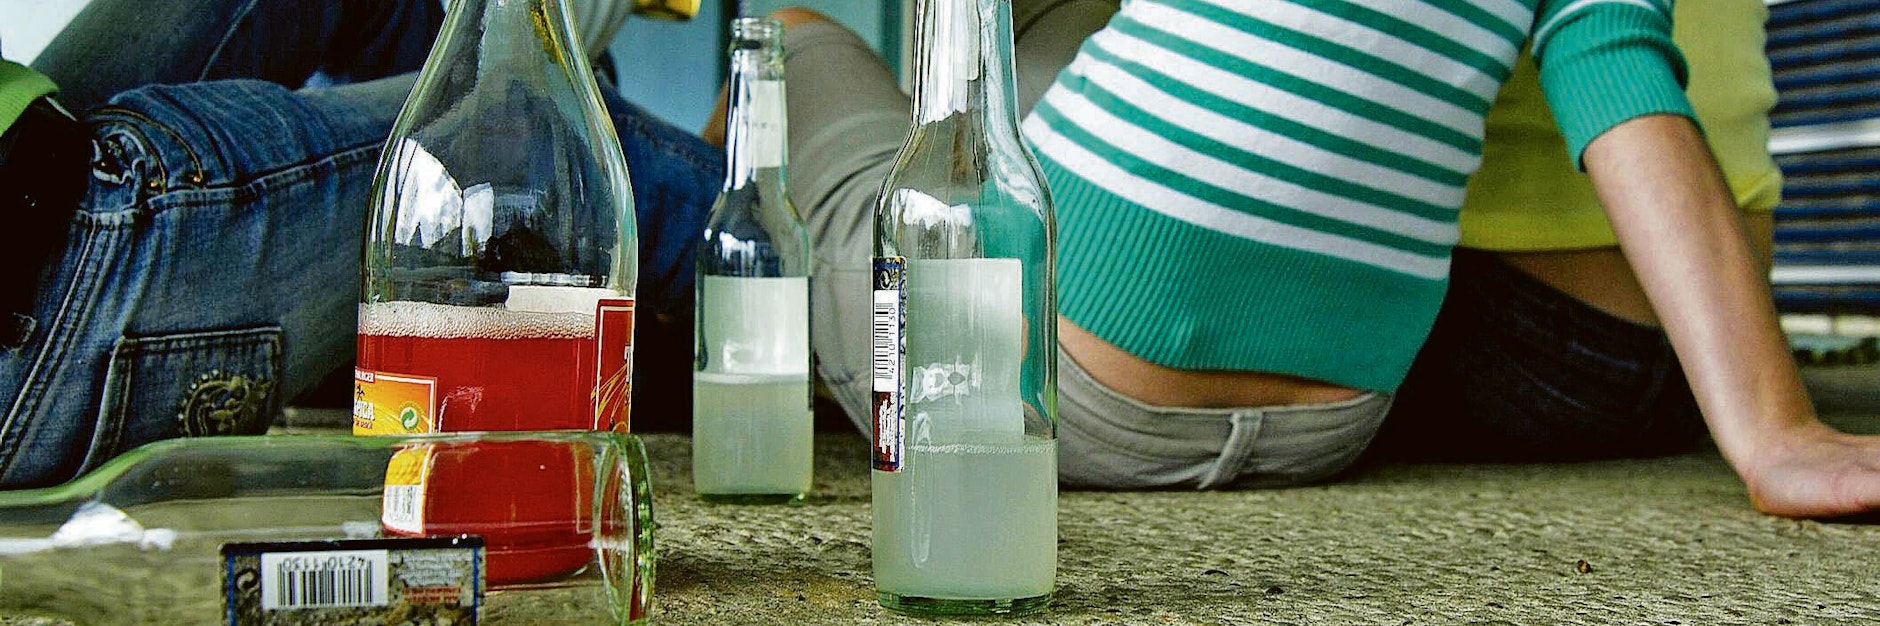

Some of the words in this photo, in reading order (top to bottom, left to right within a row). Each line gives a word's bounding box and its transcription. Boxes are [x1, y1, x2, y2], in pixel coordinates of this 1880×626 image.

[888, 307, 896, 336] 1130
[888, 343, 896, 374] 4210
[282, 556, 320, 571] 1130
[327, 556, 365, 570] 4210
